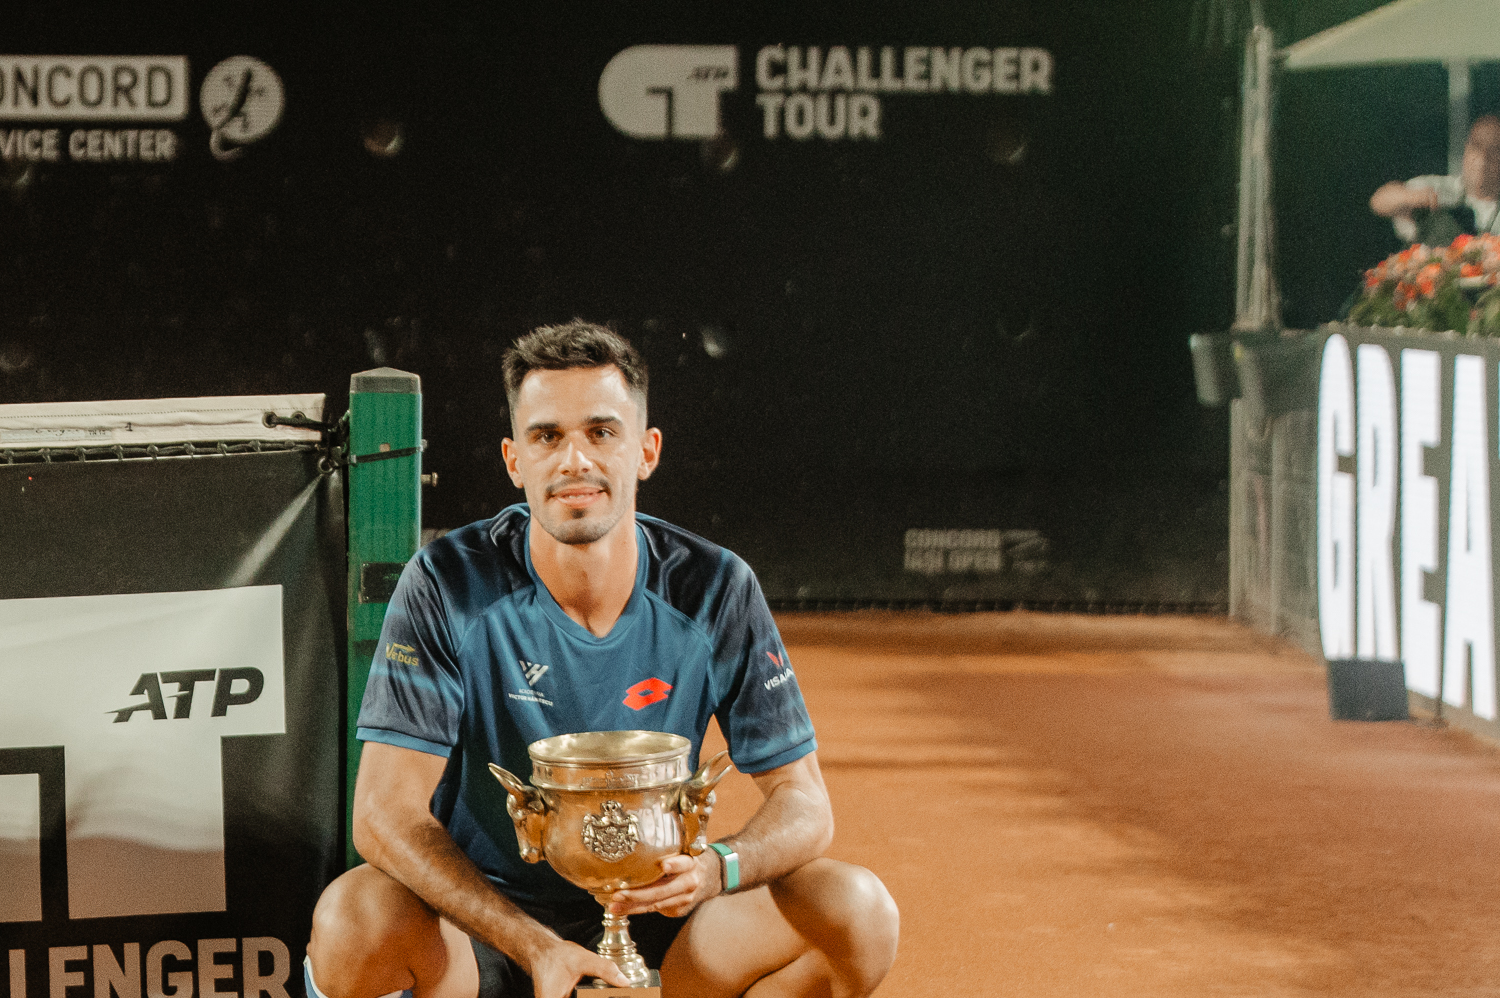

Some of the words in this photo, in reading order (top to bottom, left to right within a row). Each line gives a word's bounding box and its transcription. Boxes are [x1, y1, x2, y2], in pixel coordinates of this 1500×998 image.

[755, 45, 1054, 93] CHALLENGER
[755, 92, 882, 139] TOUR
[68, 128, 179, 162] CENTER
[1317, 333, 1500, 721] GREA
[104, 666, 264, 723] ATP
